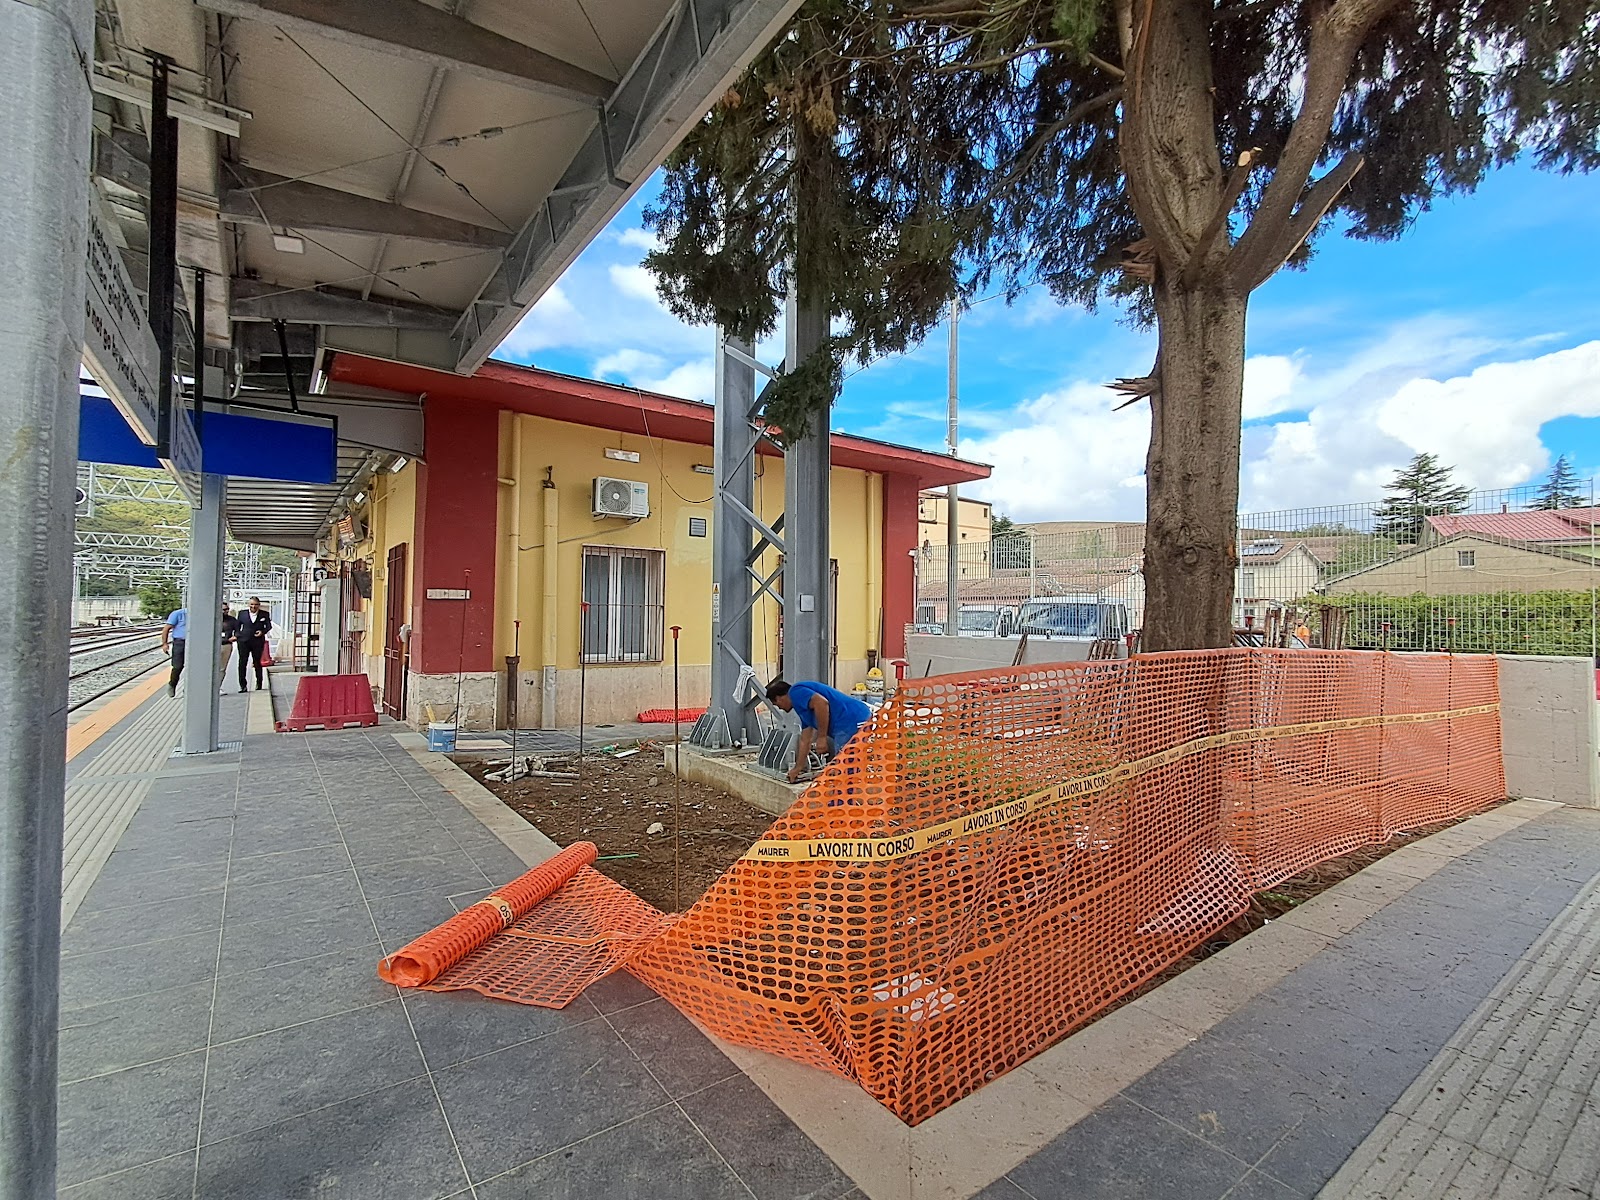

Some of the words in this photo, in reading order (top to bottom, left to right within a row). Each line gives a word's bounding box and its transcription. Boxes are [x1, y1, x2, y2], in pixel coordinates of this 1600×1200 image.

[757, 846, 790, 857] MAURER
[808, 842, 853, 858] LAVORI
[856, 842, 873, 858] IN
[876, 836, 915, 857] CORSO
[926, 828, 953, 844] MAURER
[962, 811, 994, 833] LAVORI
[995, 810, 1005, 823] IN
[1005, 800, 1028, 820] CORSO
[1057, 780, 1083, 799] LAVORI
[1084, 778, 1093, 791] IN
[1093, 772, 1112, 789] CORSO
